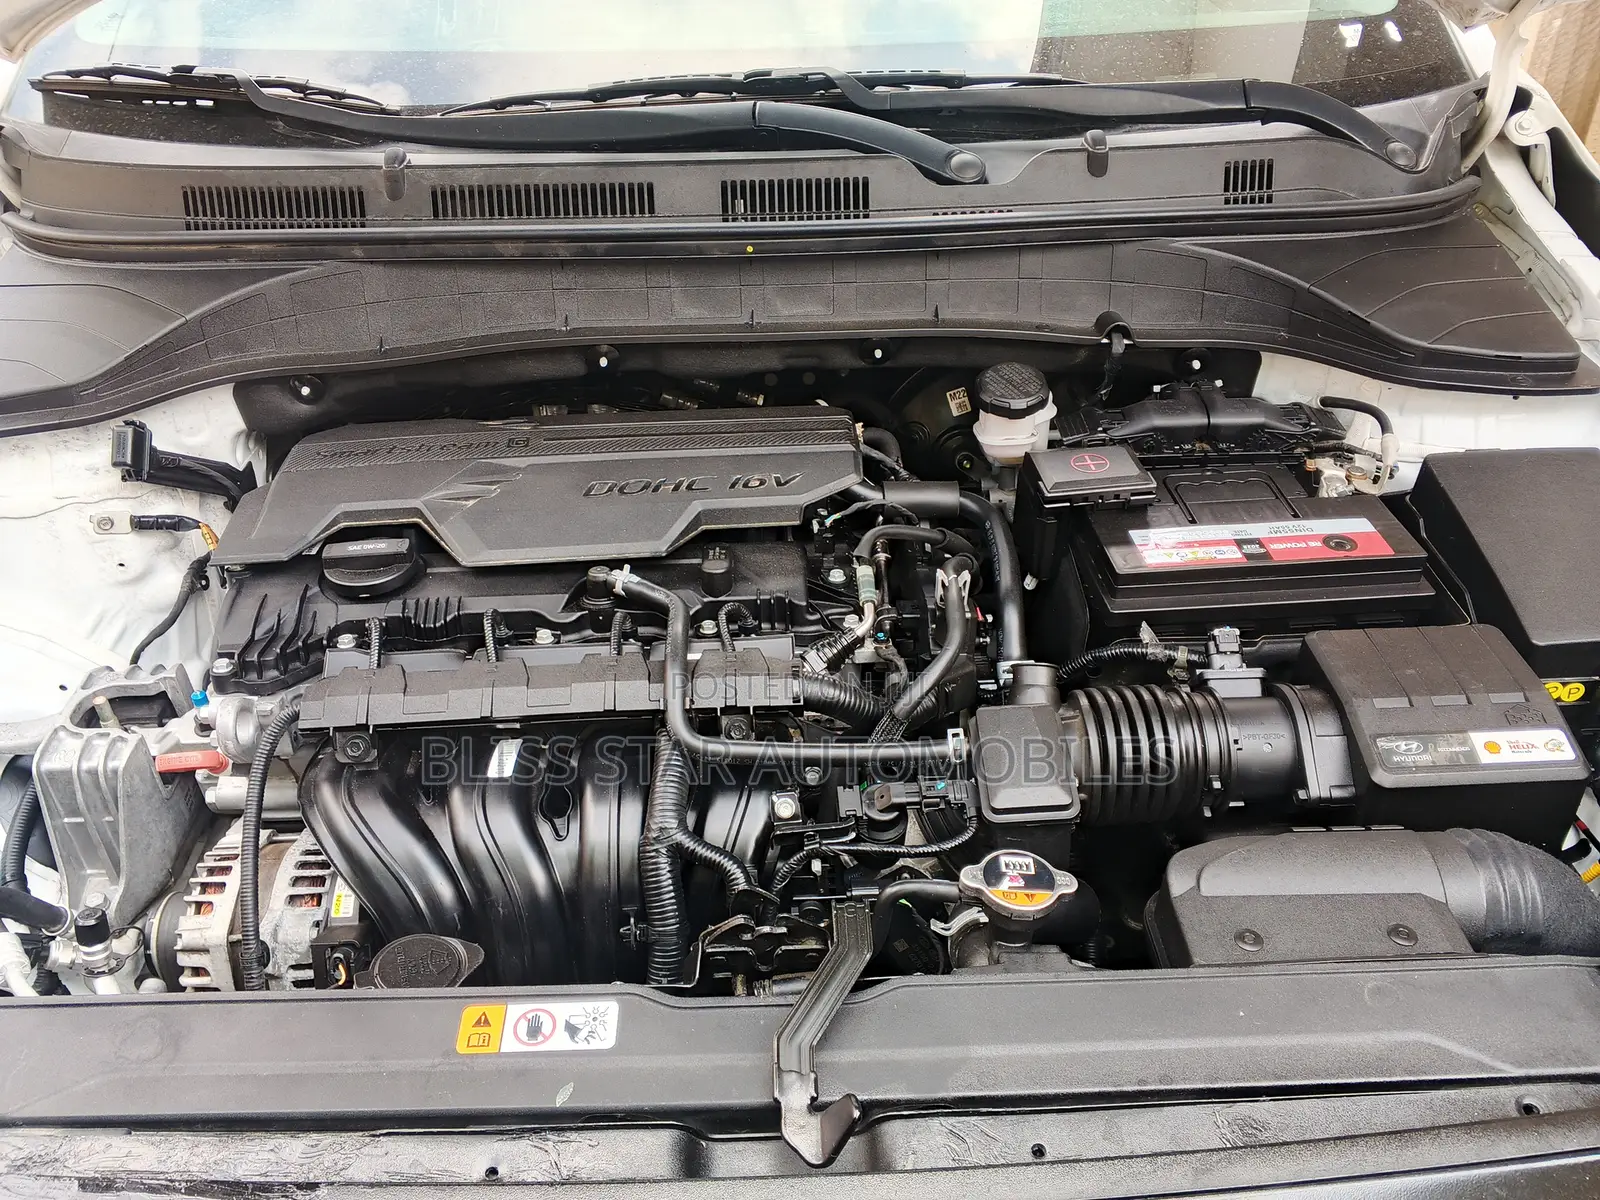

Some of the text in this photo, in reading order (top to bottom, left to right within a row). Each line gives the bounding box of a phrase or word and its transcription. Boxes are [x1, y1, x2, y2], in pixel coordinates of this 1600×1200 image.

[949, 389, 967, 402] M22
[582, 472, 807, 497] DOHC 16V
[1269, 542, 1308, 550] POWER
